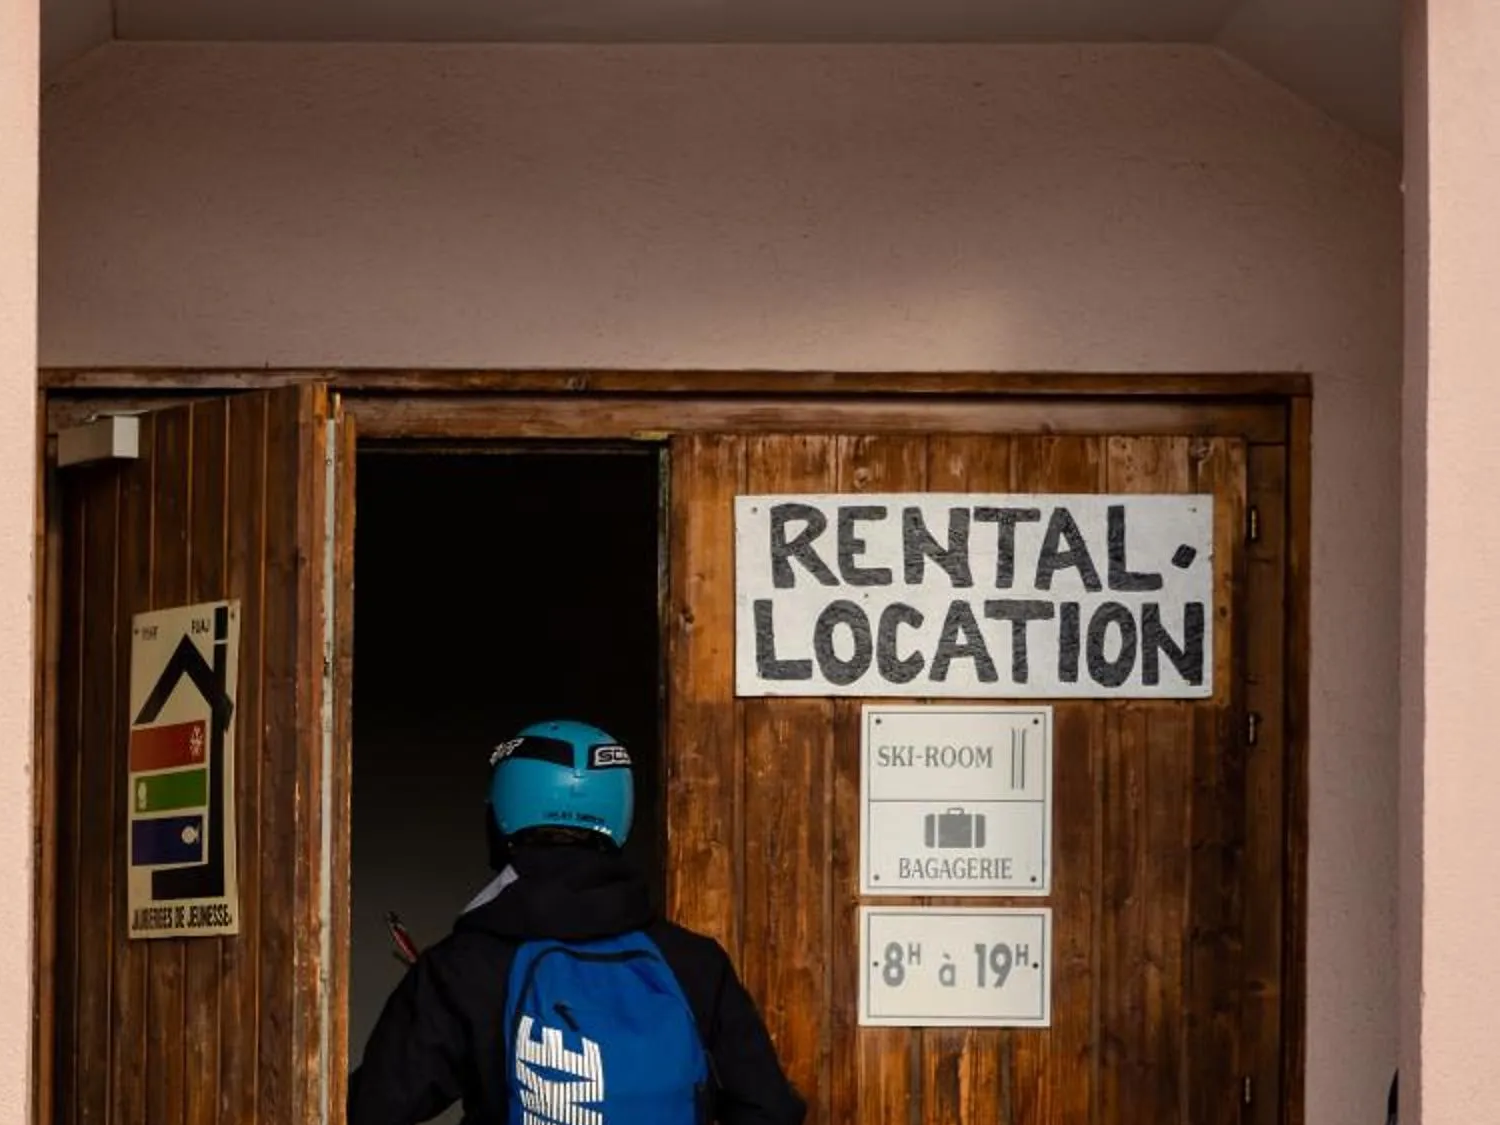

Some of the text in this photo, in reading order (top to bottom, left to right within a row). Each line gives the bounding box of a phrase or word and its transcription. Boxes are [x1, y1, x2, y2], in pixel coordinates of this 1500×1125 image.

[753, 599, 1206, 687] LOCATION
[876, 745, 994, 769] SKI-ROOM
[898, 857, 1013, 880] BAGAGERIE
[938, 953, 956, 987] à
